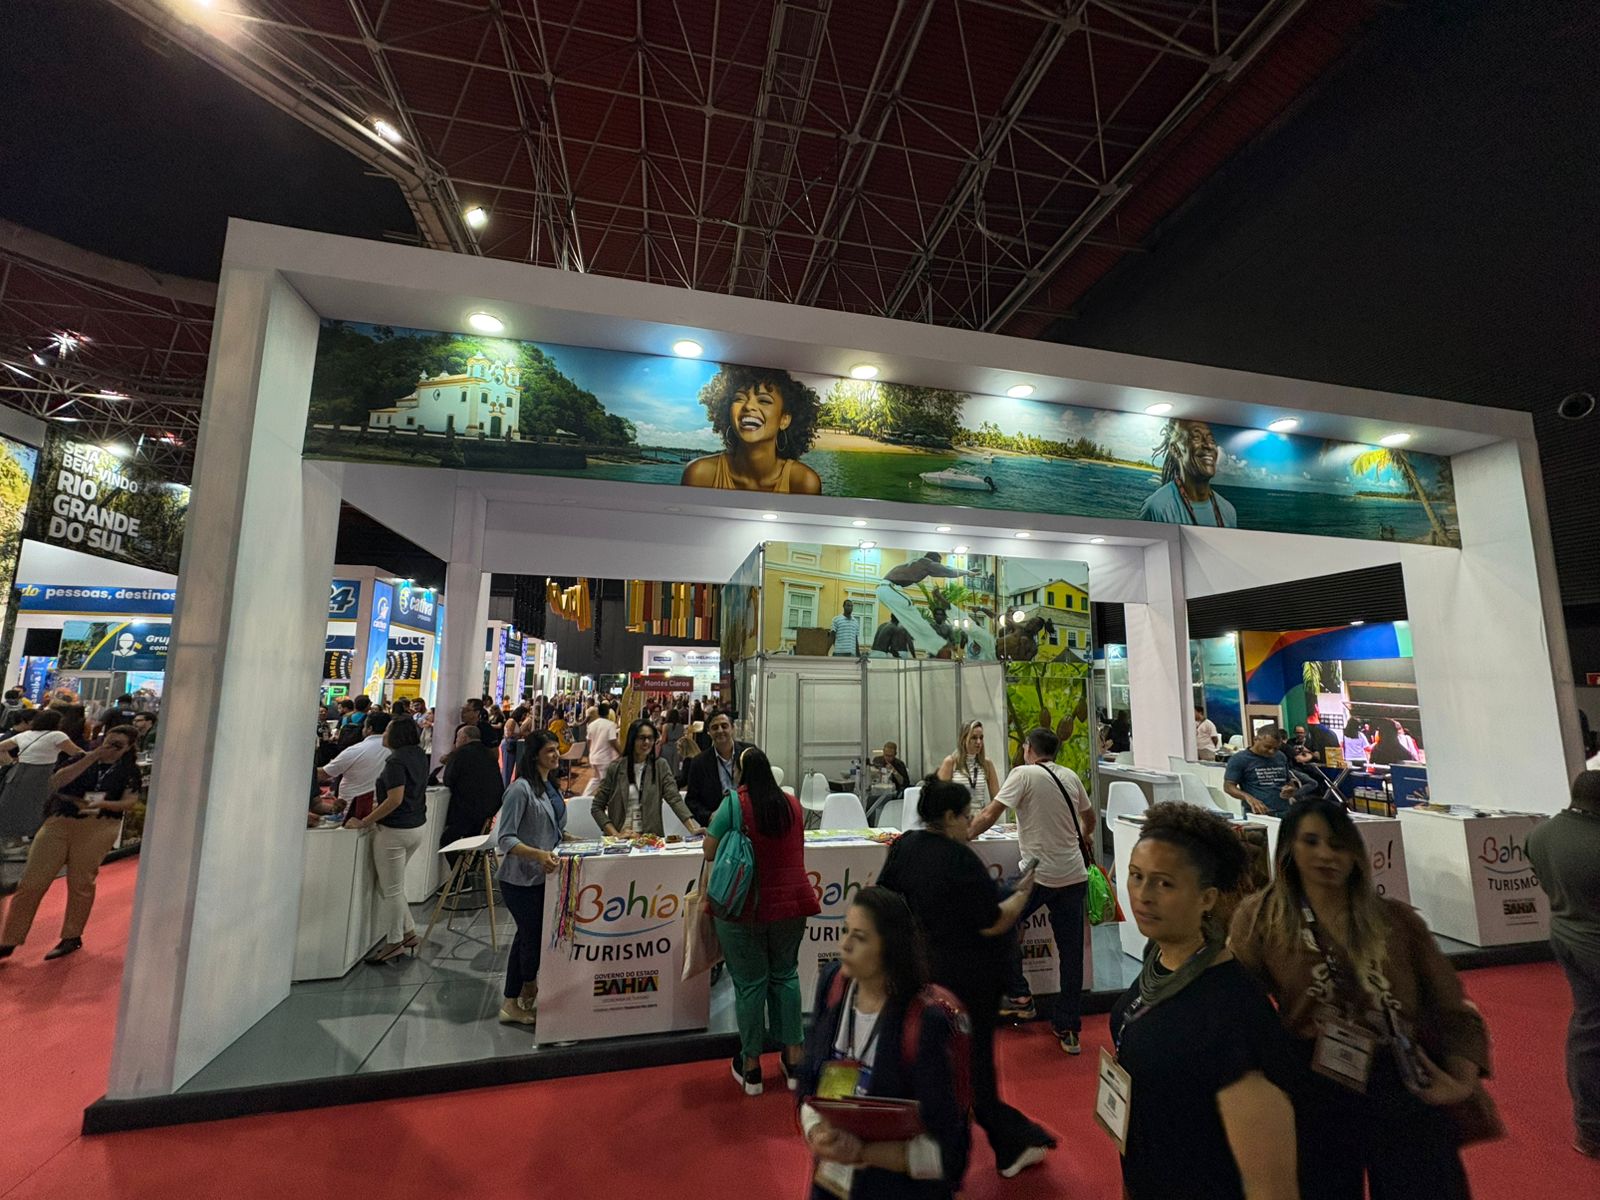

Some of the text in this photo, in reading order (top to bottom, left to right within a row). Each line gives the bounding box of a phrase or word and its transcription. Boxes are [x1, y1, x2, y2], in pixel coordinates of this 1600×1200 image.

[64, 441, 99, 464] SEJA
[57, 470, 97, 500] RIO
[62, 454, 138, 493] BEM-VINDO
[53, 495, 140, 537] GRANDE
[50, 516, 126, 555] DO SUL
[45, 588, 112, 599] pessoas,
[115, 589, 176, 601] destinos
[1488, 875, 1539, 892] TURISMO
[573, 937, 671, 962] TURISMO
[593, 976, 658, 996] BAHIA
[595, 972, 625, 980] GOVERNO
